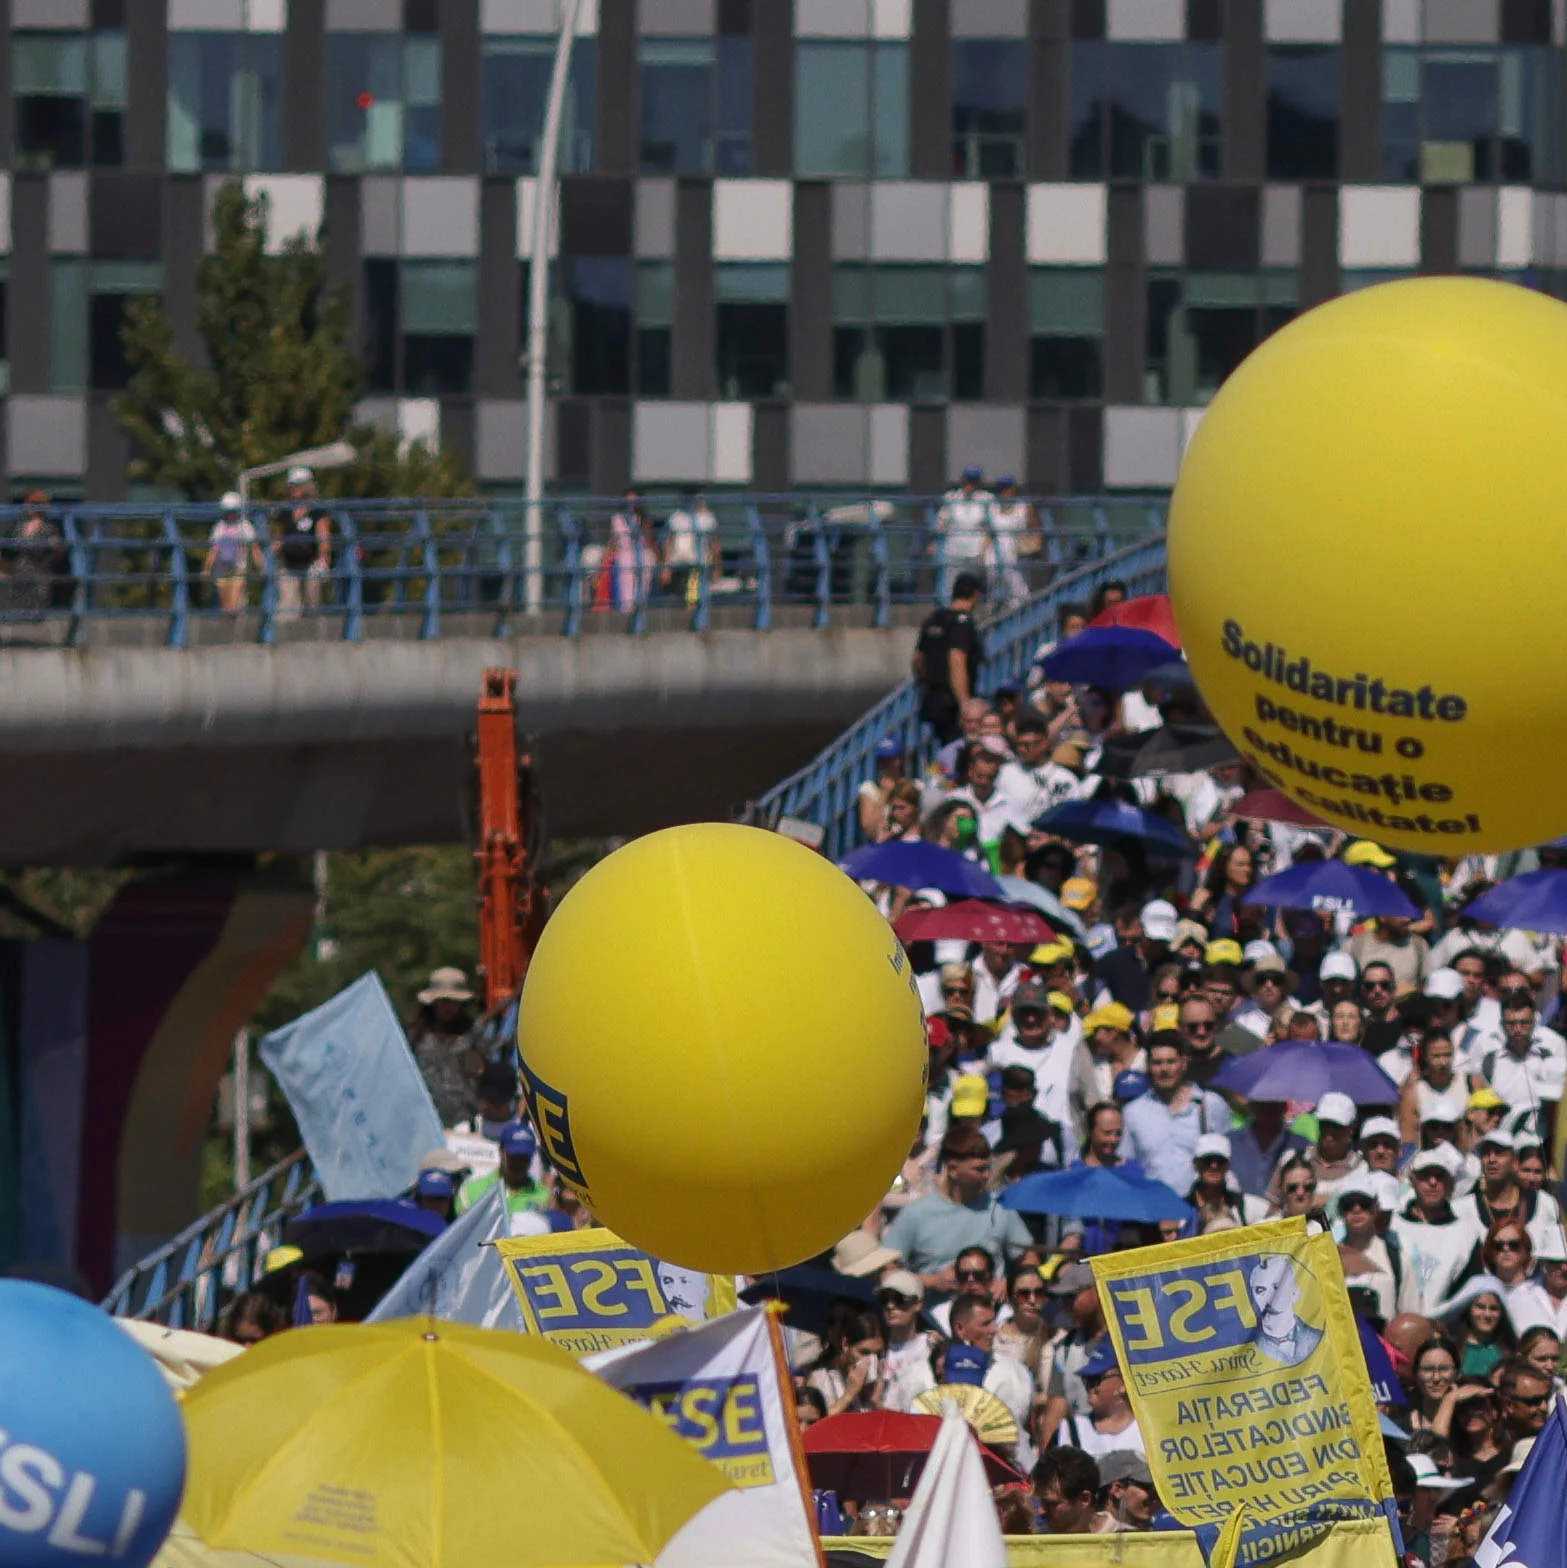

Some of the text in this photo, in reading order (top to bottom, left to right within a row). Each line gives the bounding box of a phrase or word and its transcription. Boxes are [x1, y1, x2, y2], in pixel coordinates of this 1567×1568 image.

[1222, 619, 1468, 722] Solidaritate
[1254, 693, 1424, 759] pentru o
[1243, 726, 1453, 806] educație
[1295, 786, 1481, 834] calitate!
